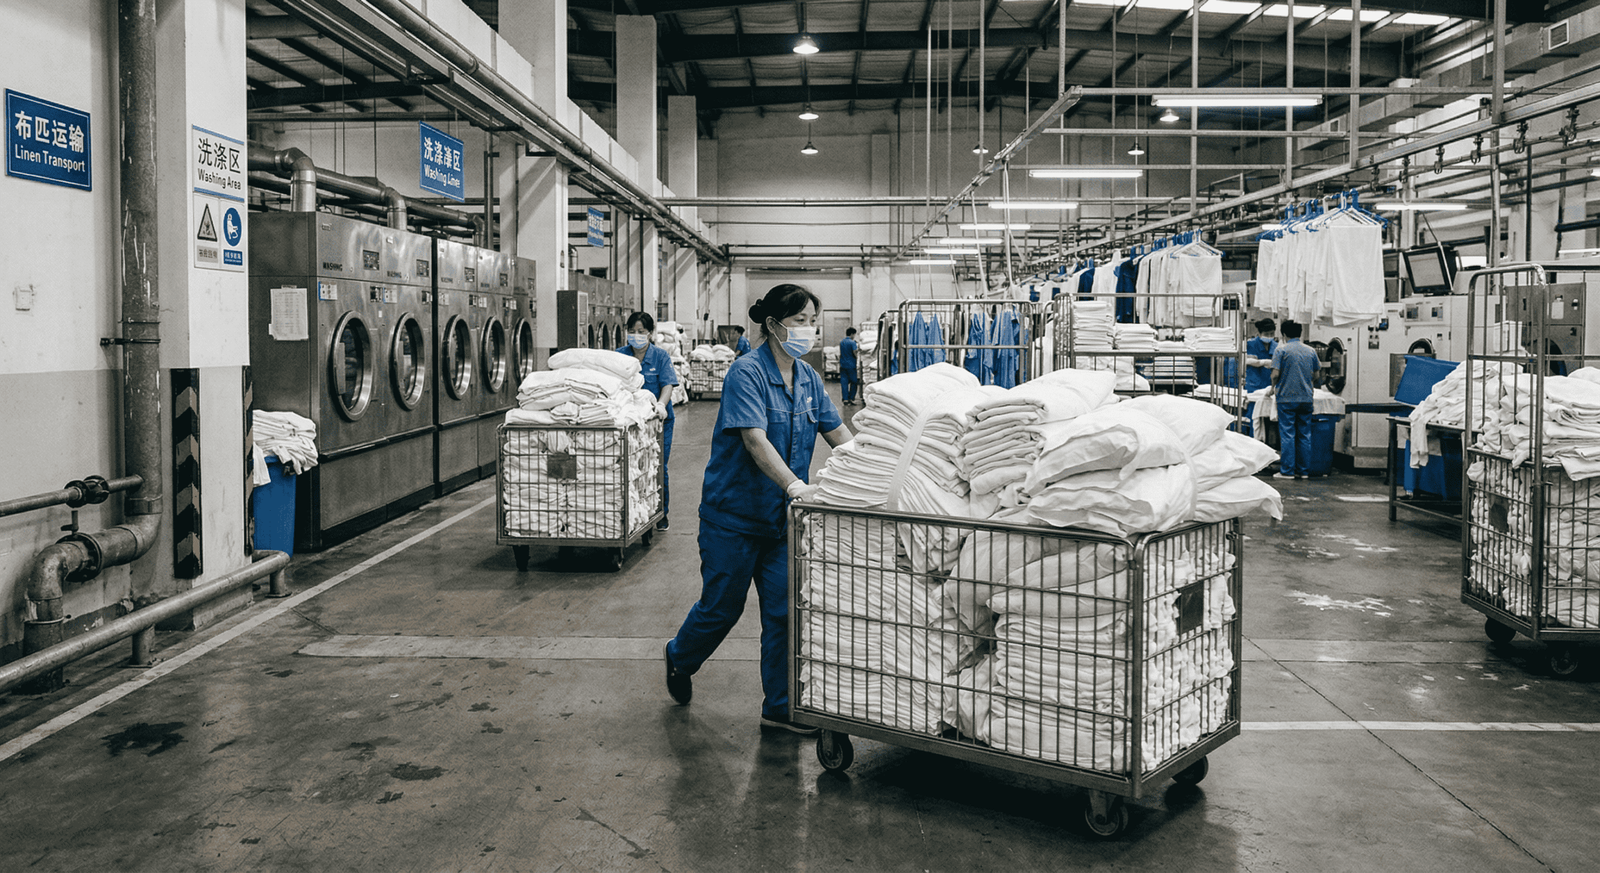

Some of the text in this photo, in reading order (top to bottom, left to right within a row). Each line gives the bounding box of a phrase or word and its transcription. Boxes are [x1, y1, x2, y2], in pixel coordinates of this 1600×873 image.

[15, 110, 84, 153] 布匹运输
[15, 144, 86, 173] Linen Transport
[198, 137, 241, 174] 洗涤区
[198, 168, 241, 190] Washing Area
